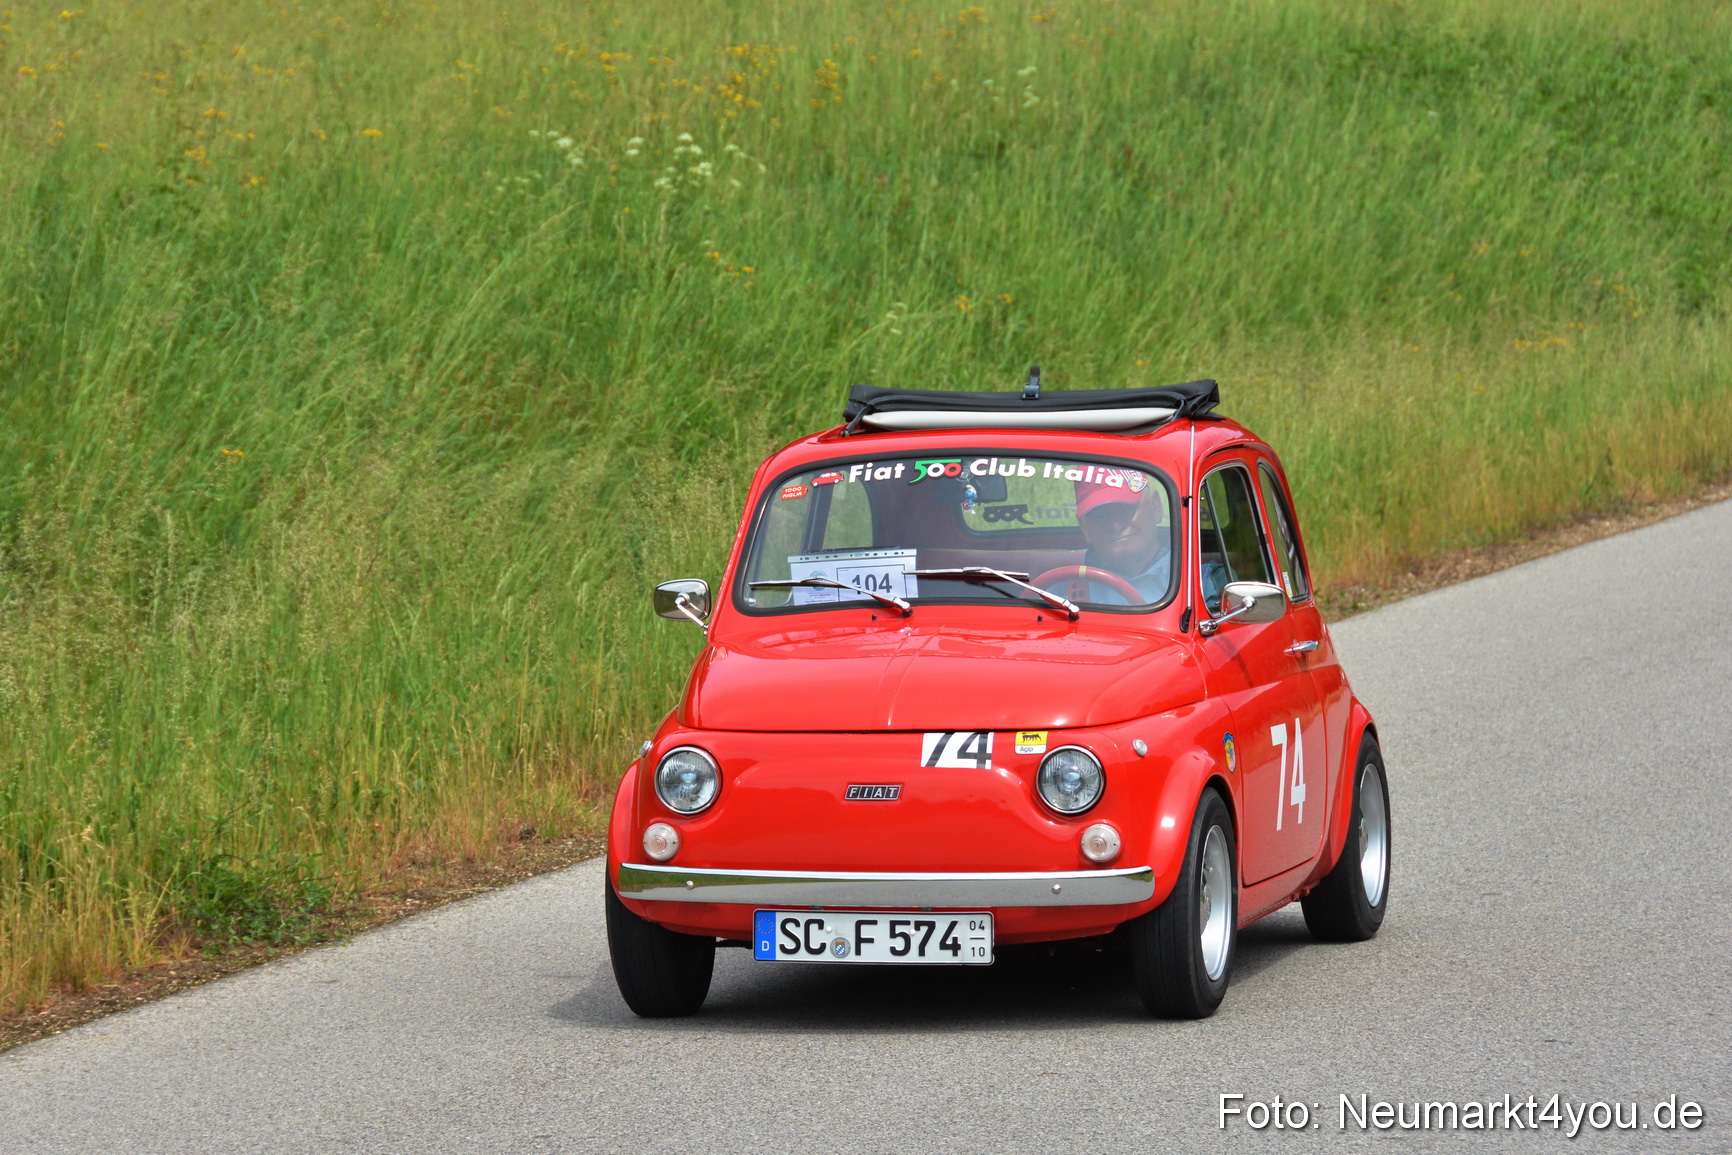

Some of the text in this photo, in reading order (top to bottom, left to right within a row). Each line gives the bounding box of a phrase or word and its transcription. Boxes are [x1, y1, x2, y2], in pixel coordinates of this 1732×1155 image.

[848, 462, 905, 483] Fiat
[909, 458, 962, 484] 500
[969, 457, 1036, 478] Club
[1042, 462, 1124, 488] Italia
[852, 573, 892, 595] 104
[924, 732, 992, 769] 74
[1270, 717, 1306, 831] 74
[848, 787, 898, 798] FIAT
[969, 920, 985, 931] 04
[761, 941, 770, 952] D
[779, 917, 962, 957] SC F 574
[971, 946, 986, 957] 10
